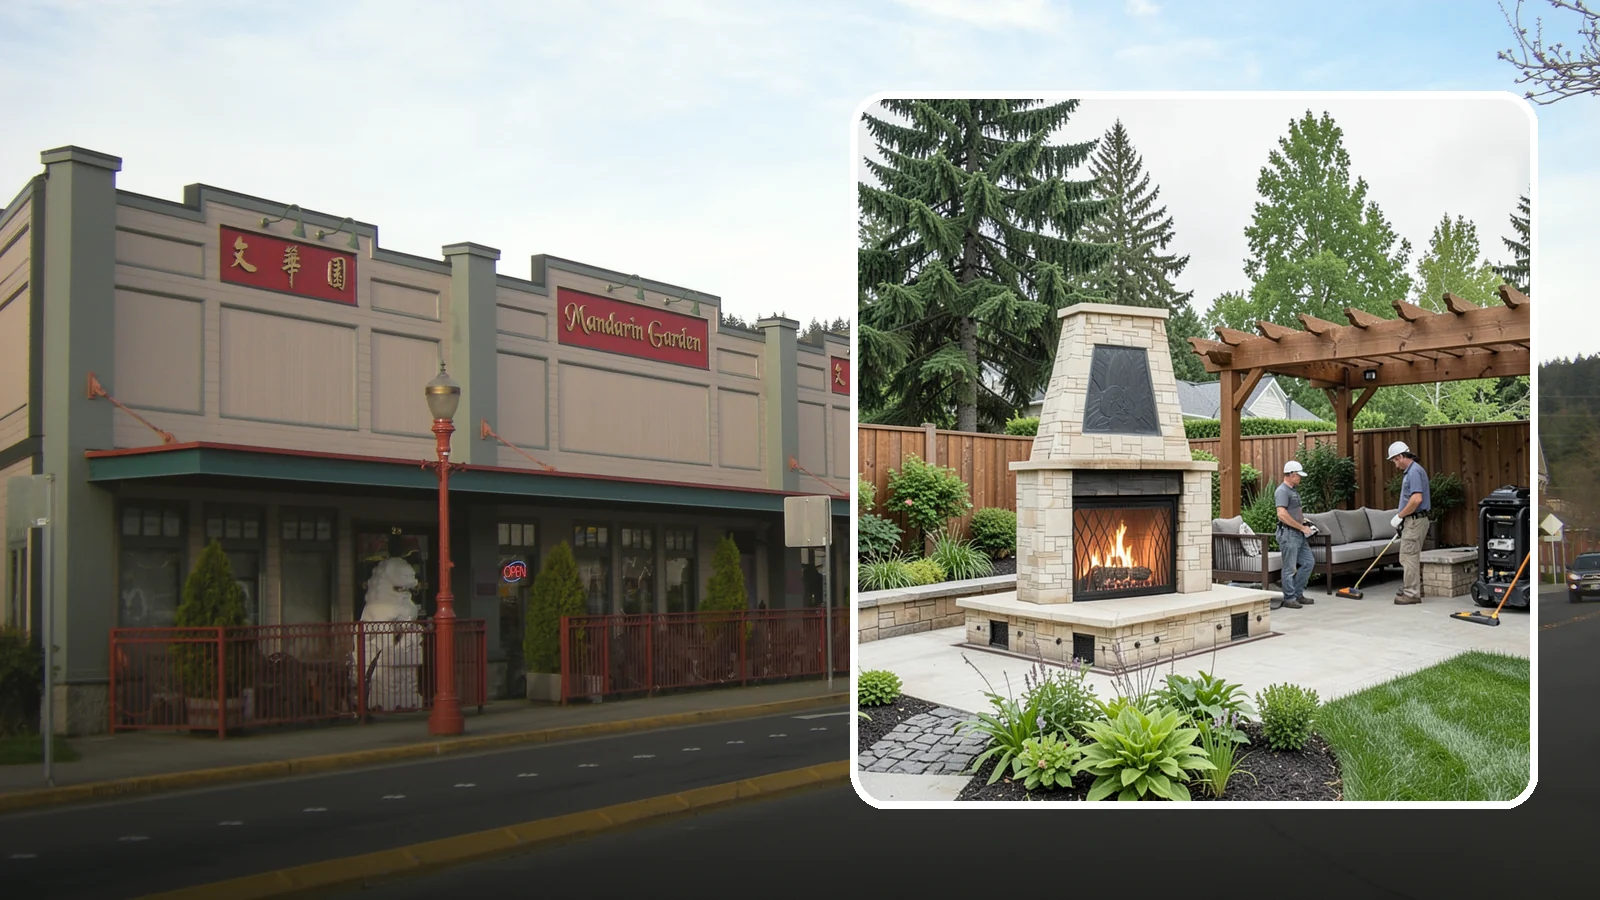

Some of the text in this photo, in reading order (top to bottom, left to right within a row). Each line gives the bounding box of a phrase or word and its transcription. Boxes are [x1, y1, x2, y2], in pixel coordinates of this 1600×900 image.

[230, 235, 346, 291] 文華園
[564, 301, 702, 352] Mandarin Garden
[503, 565, 527, 578] OPEN
